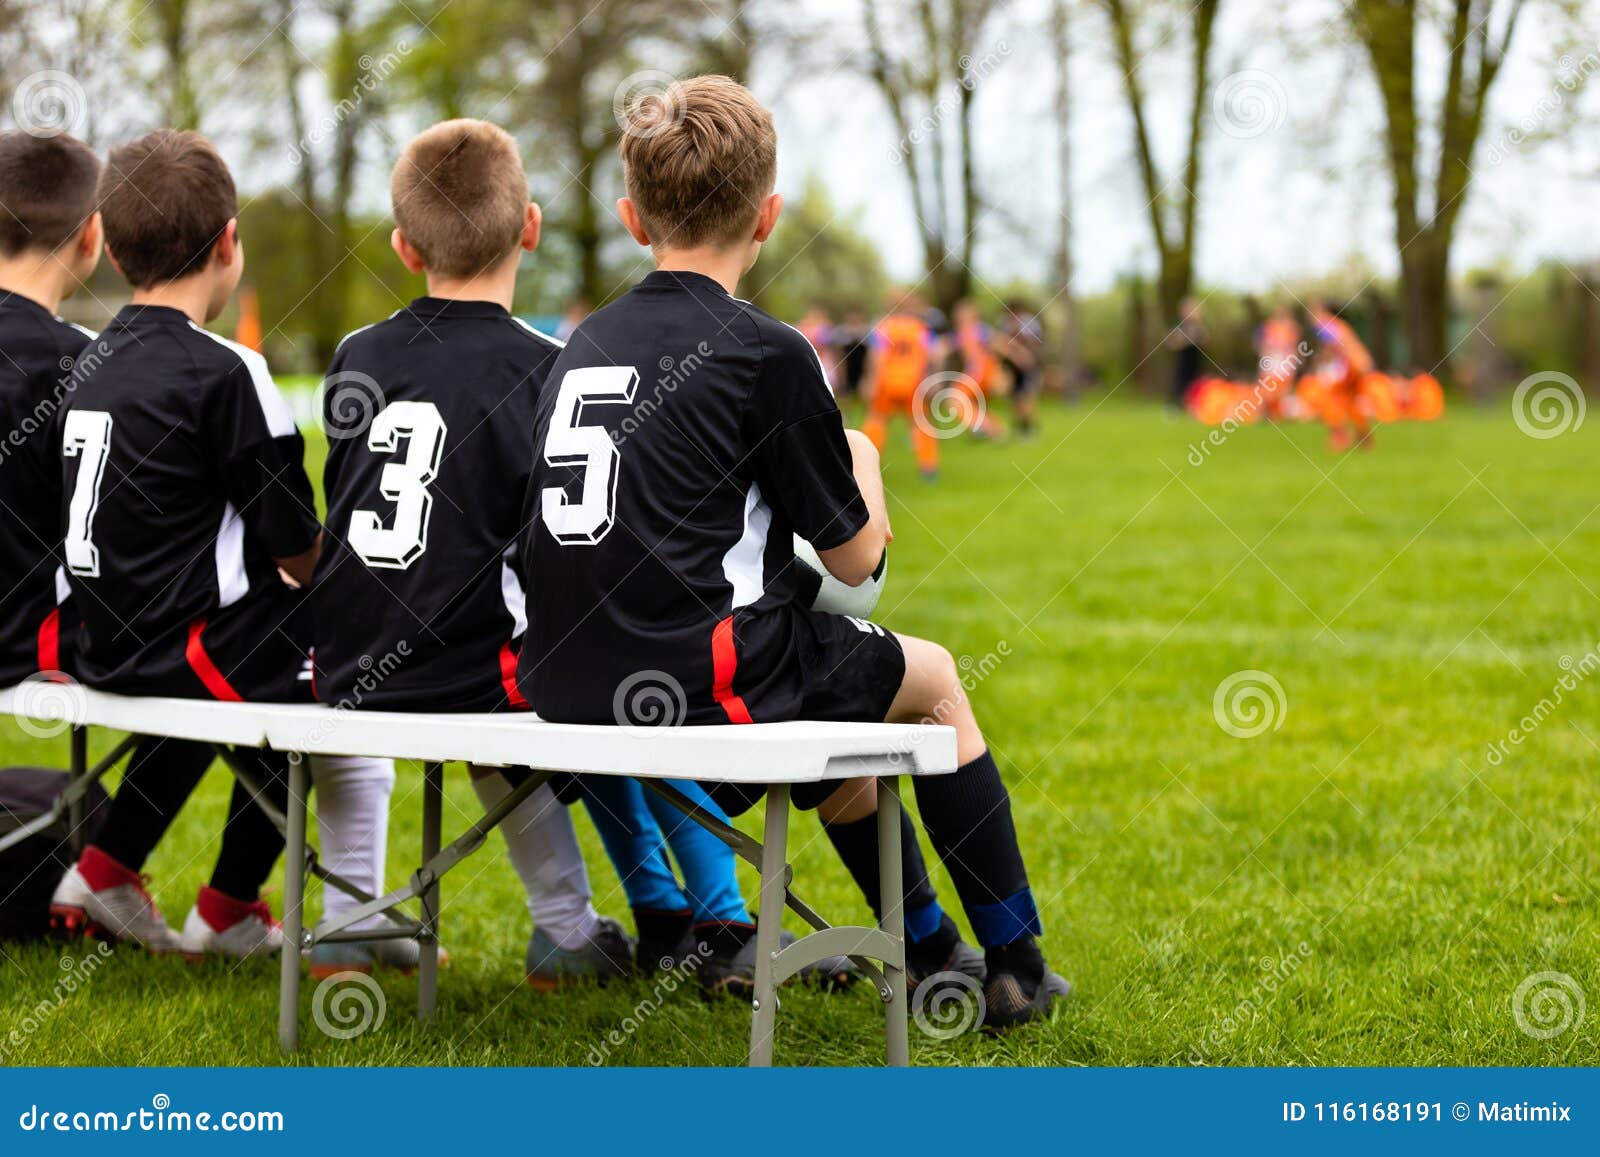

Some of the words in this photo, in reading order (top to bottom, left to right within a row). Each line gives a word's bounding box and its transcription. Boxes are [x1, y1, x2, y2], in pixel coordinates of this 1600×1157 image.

[63, 410, 113, 578] 7
[347, 401, 448, 570] 3
[541, 366, 641, 546] 5
